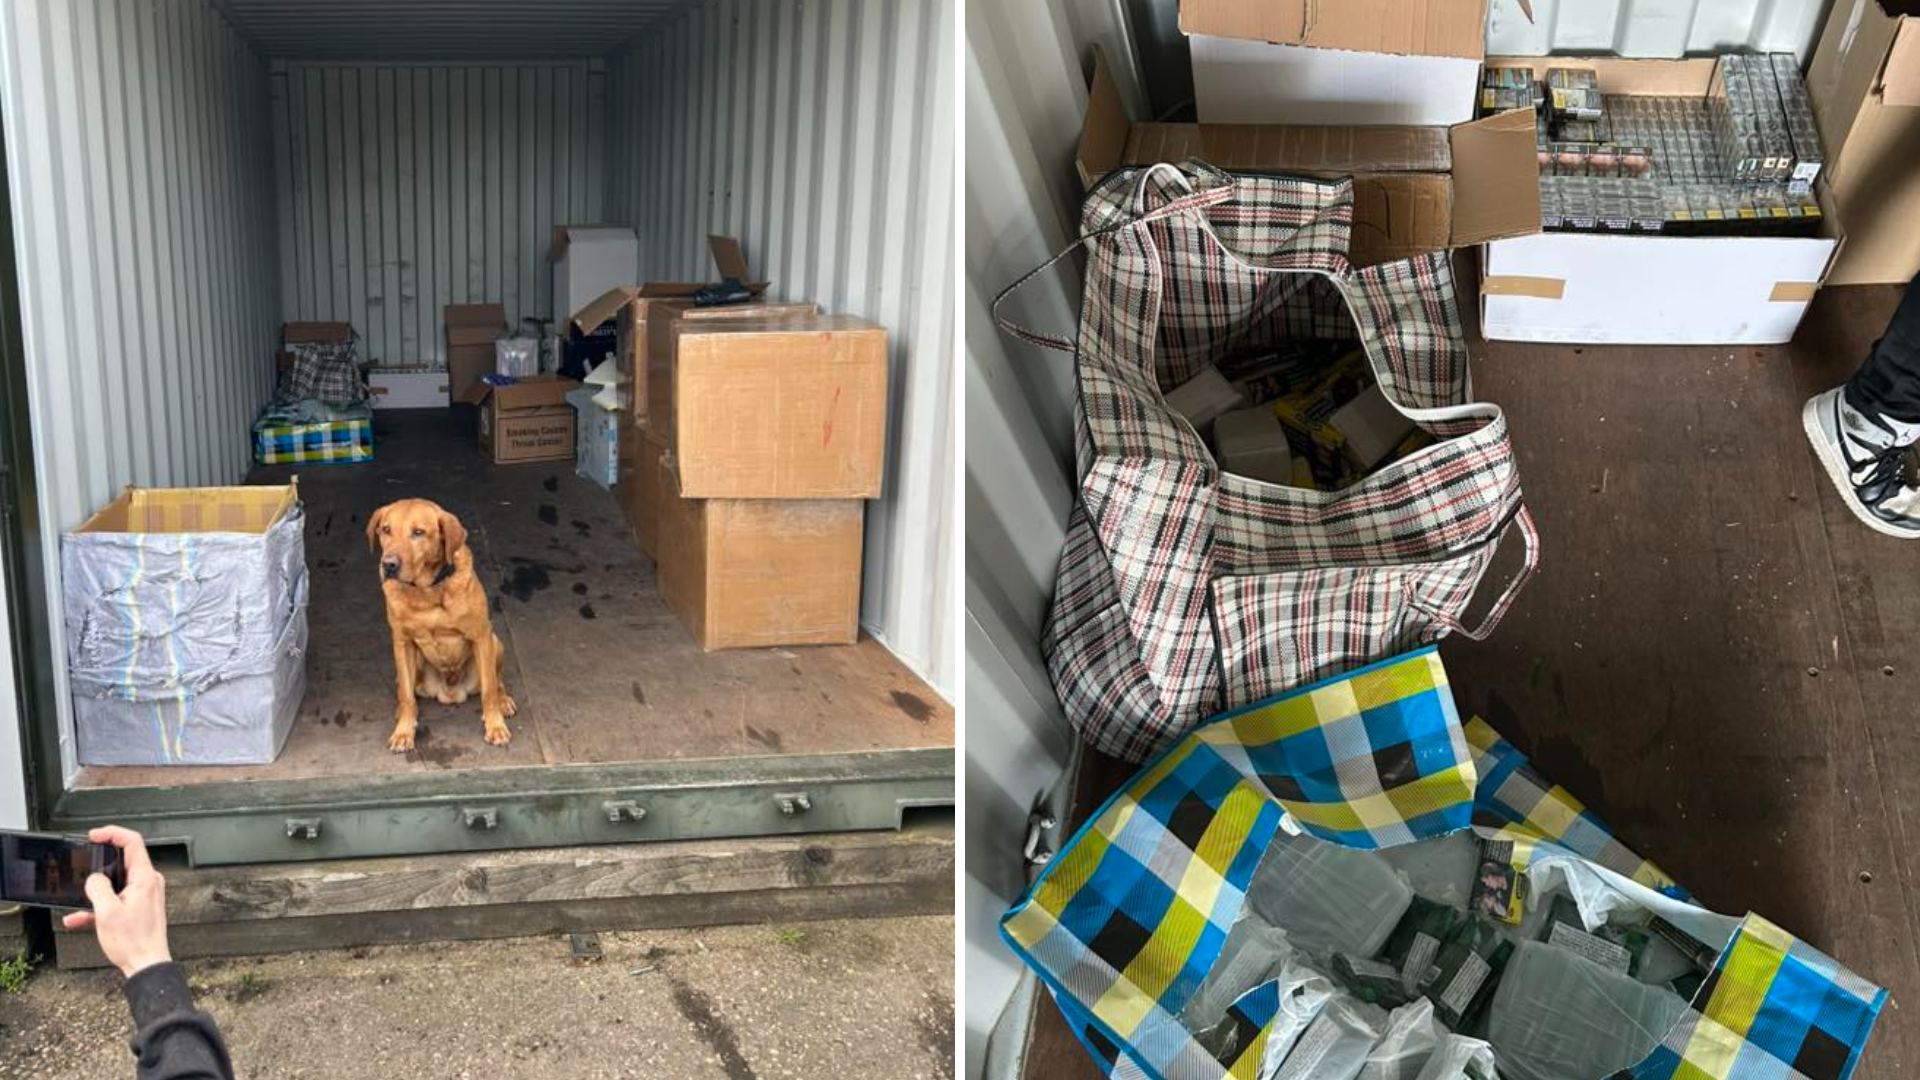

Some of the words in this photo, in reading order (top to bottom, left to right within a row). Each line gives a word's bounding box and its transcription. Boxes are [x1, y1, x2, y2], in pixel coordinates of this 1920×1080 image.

[506, 428, 539, 438] Smoking
[541, 426, 568, 435] Causes
[537, 438, 563, 447] Cancer
